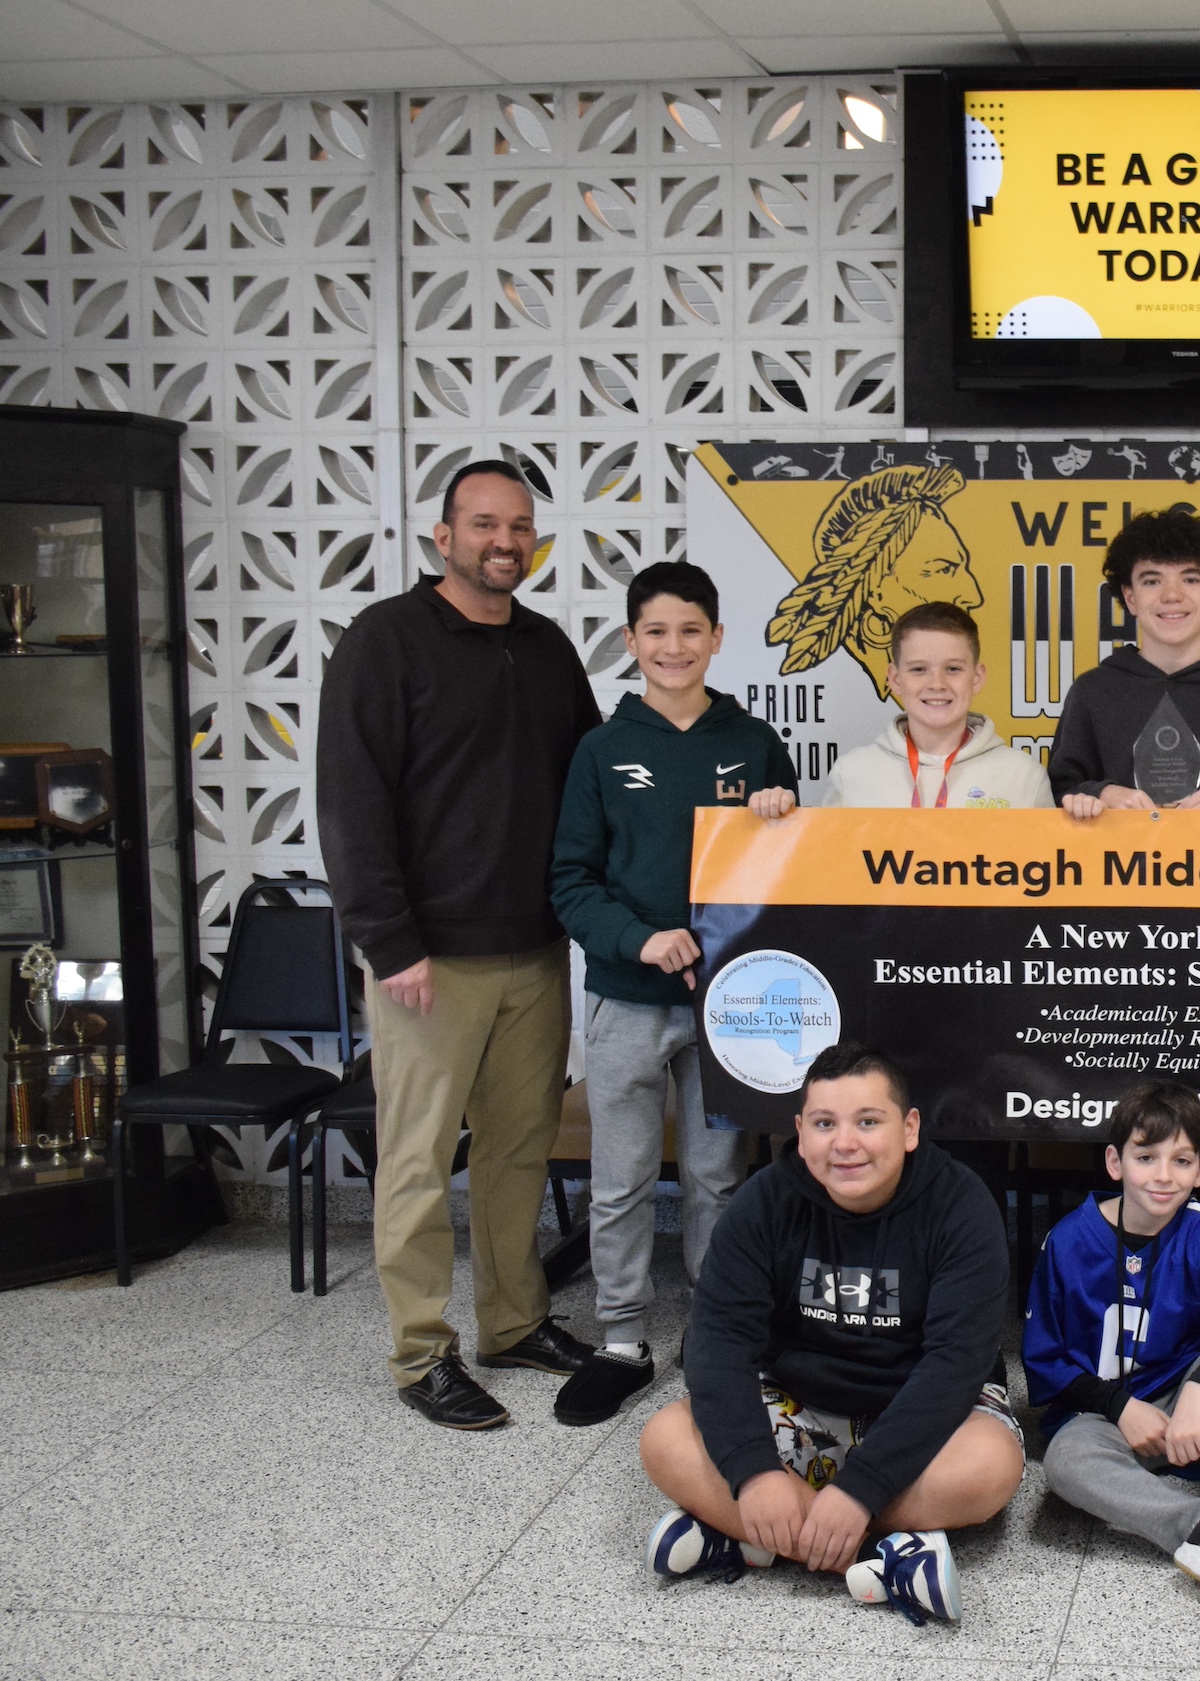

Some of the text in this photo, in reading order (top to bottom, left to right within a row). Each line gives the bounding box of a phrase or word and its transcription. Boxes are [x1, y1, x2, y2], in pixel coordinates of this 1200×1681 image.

[1057, 153, 1105, 186] BE
[1122, 153, 1152, 186] A
[747, 684, 825, 723] PRIDE
[863, 849, 1083, 897] Wantagh
[1025, 925, 1051, 949] A
[1060, 924, 1130, 950] New
[716, 955, 827, 991] Celebrating Middle-Grades Education
[874, 958, 1013, 985] Essential
[1022, 960, 1176, 987] Elements:
[723, 994, 821, 1005] Essential Elements:
[709, 1010, 832, 1027] Schools-To-Watch
[734, 1027, 800, 1035] Recognition Program
[722, 1054, 748, 1080] Honoring
[749, 1076, 791, 1088] Middle-Level
